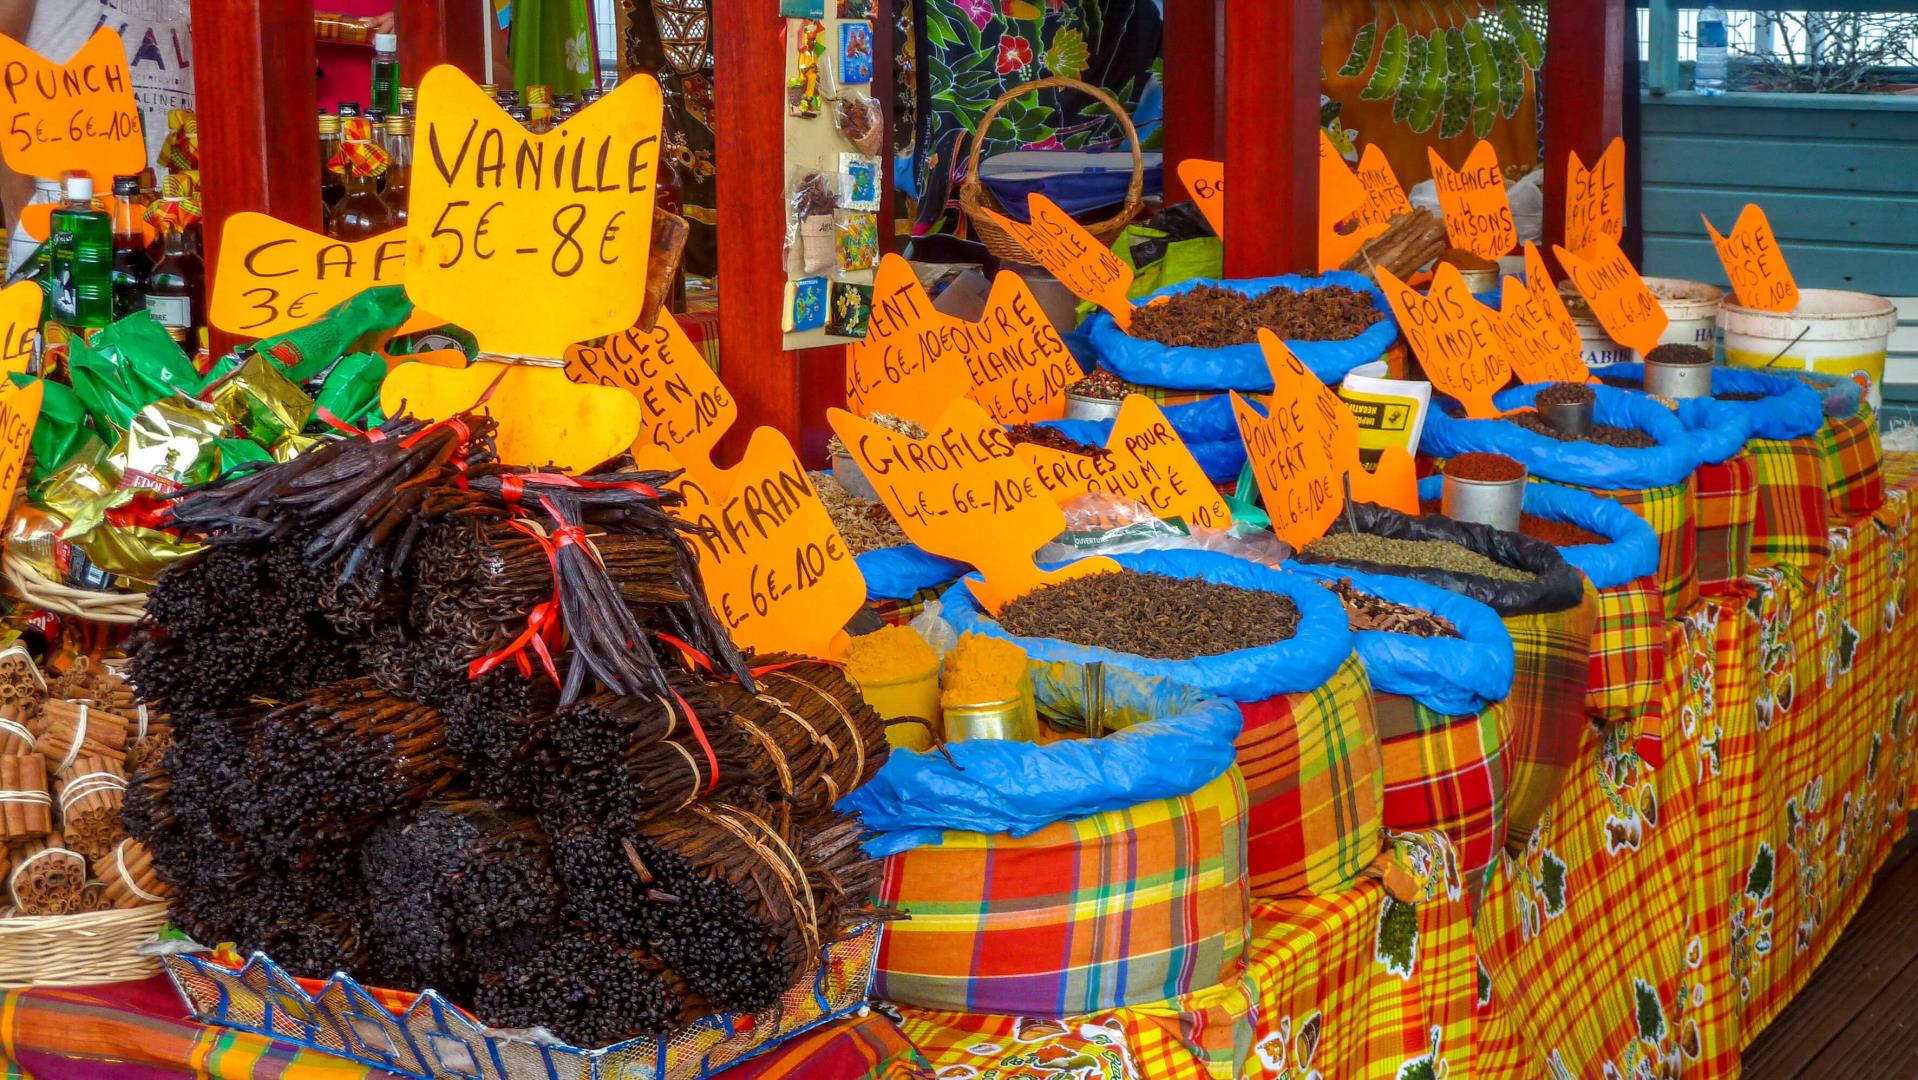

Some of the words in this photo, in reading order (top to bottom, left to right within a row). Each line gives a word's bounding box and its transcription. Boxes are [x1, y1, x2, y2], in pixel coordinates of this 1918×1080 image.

[4, 61, 125, 104] PUNCH
[239, 287, 320, 330] 3€
[1125, 422, 1175, 463] POUR
